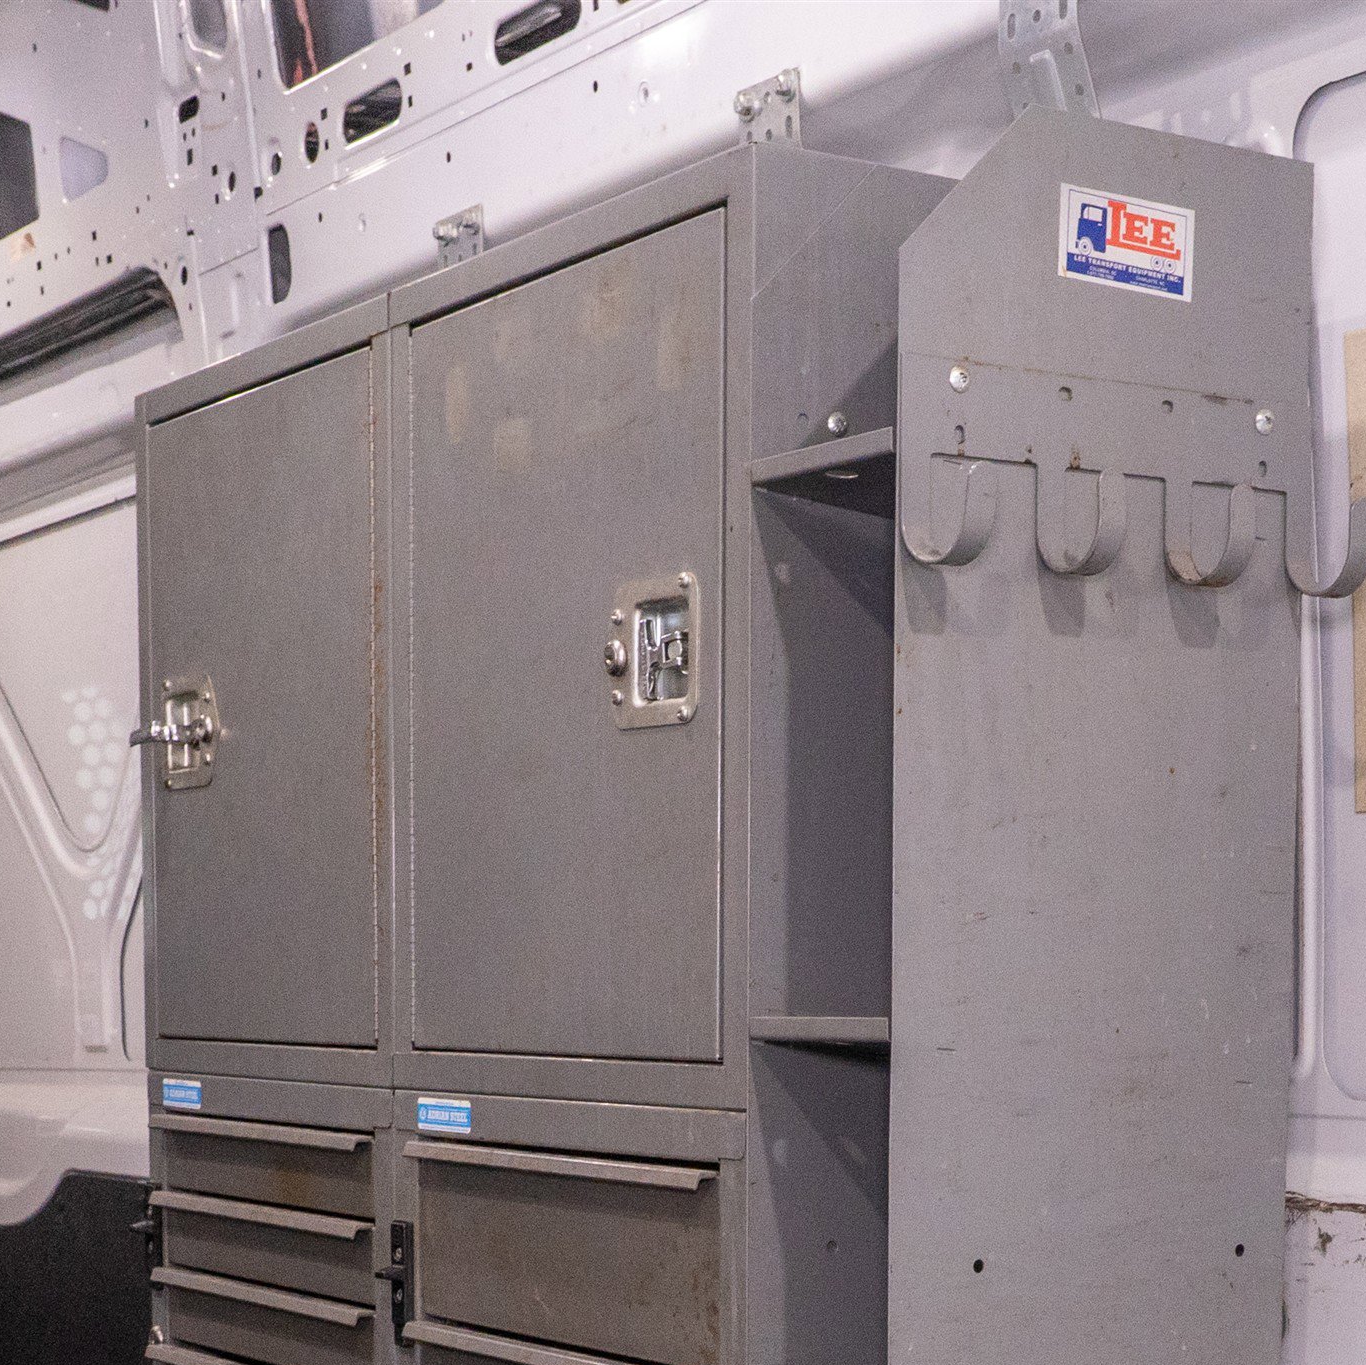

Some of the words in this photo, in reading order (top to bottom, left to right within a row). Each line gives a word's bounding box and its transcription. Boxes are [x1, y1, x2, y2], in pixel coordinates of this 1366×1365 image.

[1106, 200, 1181, 261] LEE
[1074, 255, 1086, 263] LEE
[1088, 257, 1127, 271] TRANSPORT
[1128, 265, 1166, 280] EQUIPMENT
[1166, 273, 1181, 283] INC.
